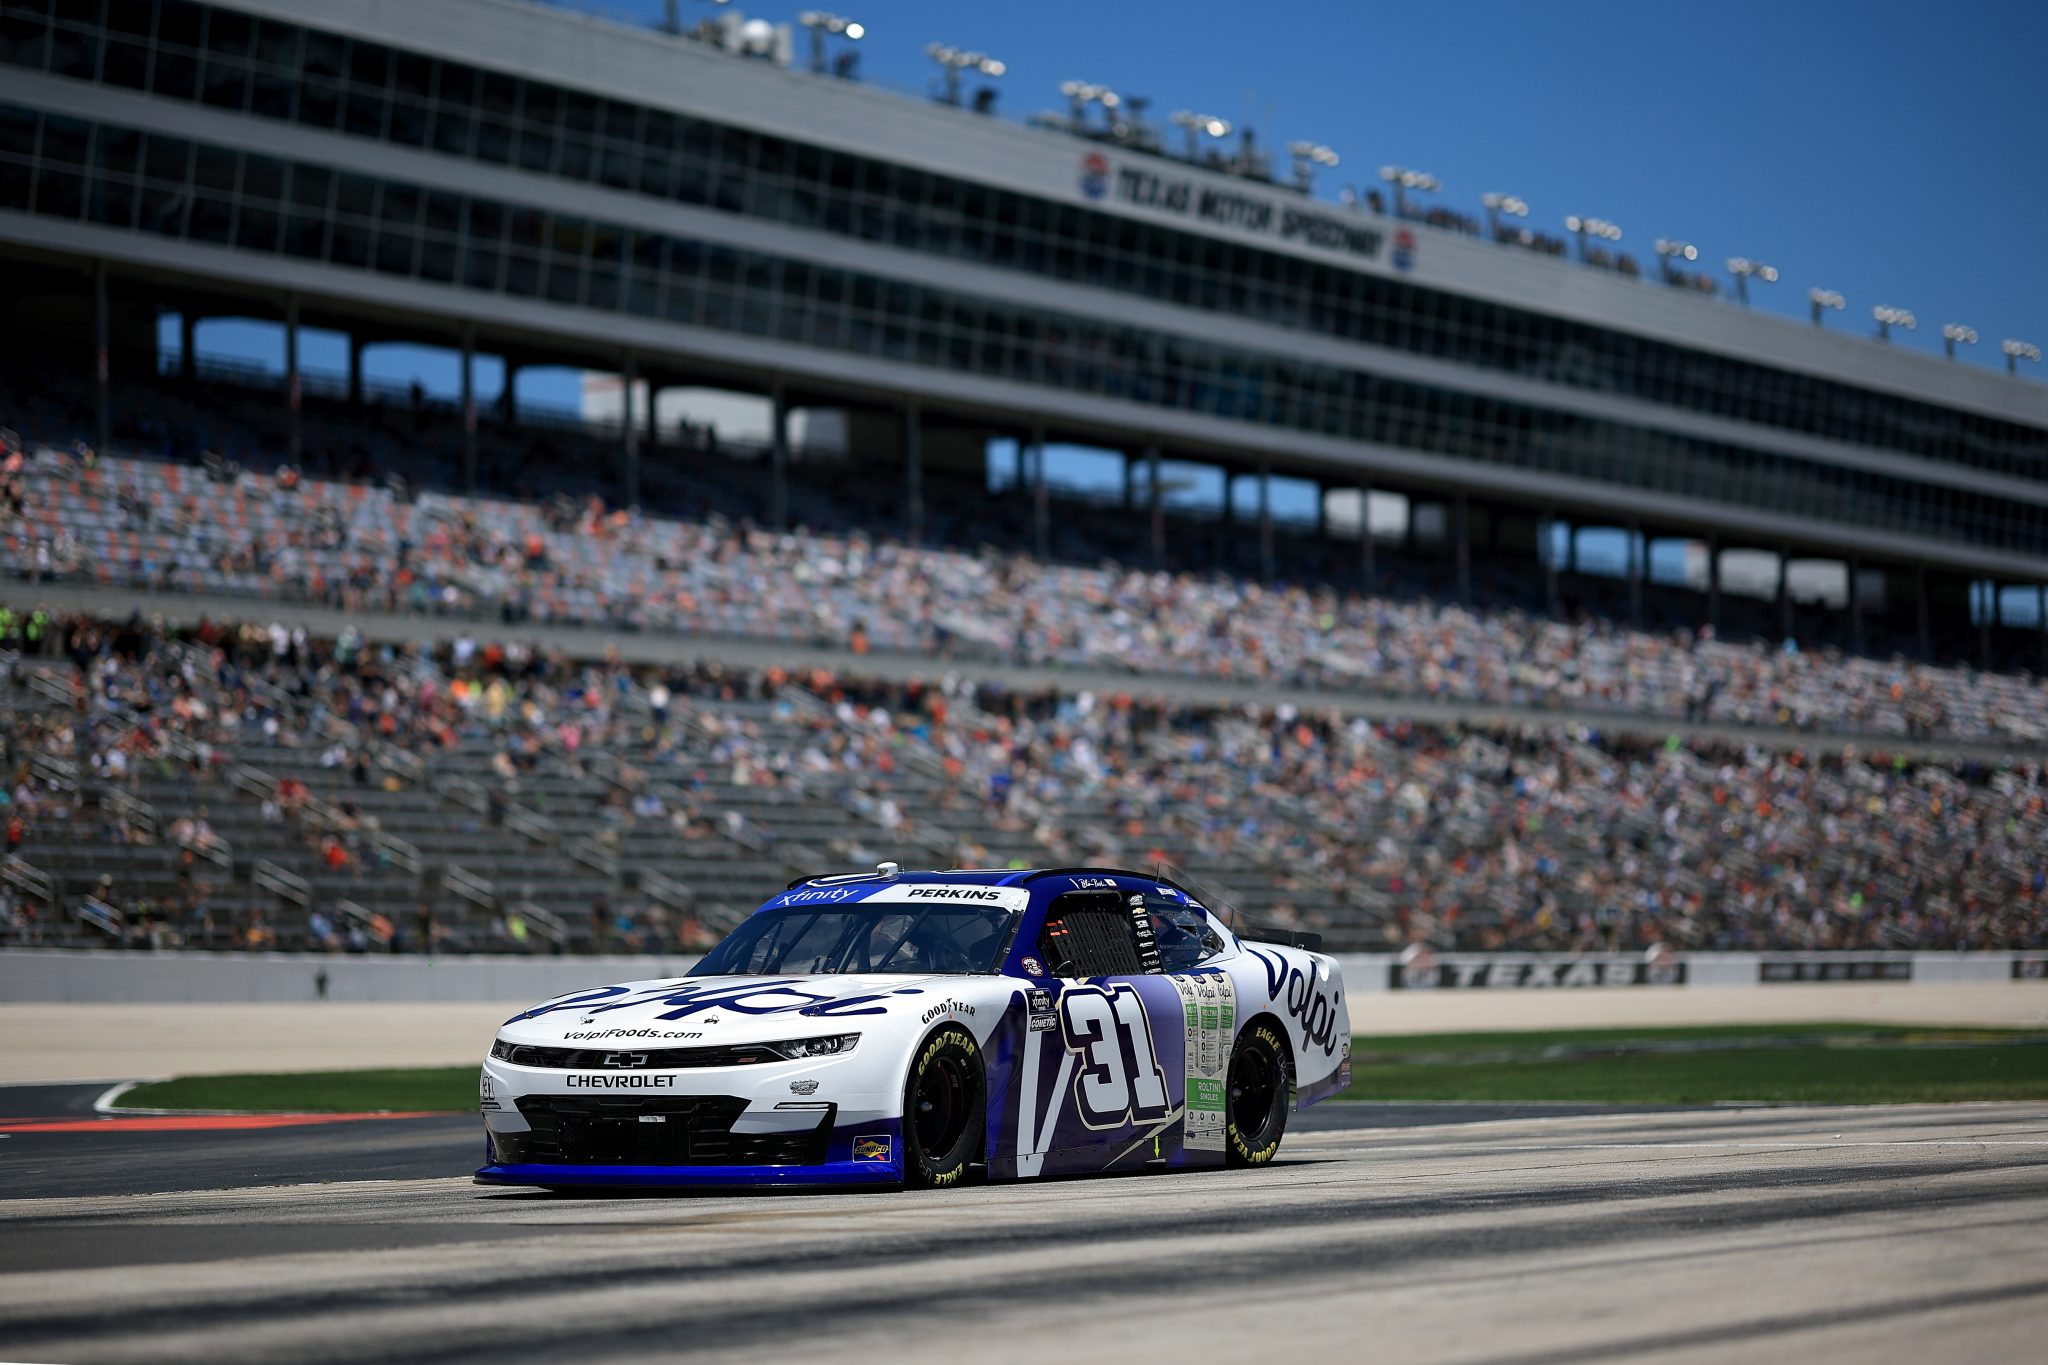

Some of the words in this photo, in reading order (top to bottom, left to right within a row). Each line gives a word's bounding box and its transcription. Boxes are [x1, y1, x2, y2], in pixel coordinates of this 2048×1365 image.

[777, 887, 860, 906] xfinity
[908, 888, 1001, 900] PERKINS
[1455, 964, 1637, 986] TEXAS
[1241, 946, 1339, 1057] Volpi
[1031, 1016, 1056, 1029] COMETIC
[563, 1028, 703, 1041] VolpiFoods.com
[1255, 1027, 1280, 1052] EAGLE
[1063, 985, 1170, 1129] 31
[482, 1076, 496, 1100] 31
[566, 1074, 677, 1088] CHEVROLET
[1197, 1082, 1222, 1093] ROLTINI
[1199, 1093, 1219, 1101] SINGLES
[854, 1144, 889, 1154] SUNOCO
[934, 1162, 963, 1185] EAGLE
